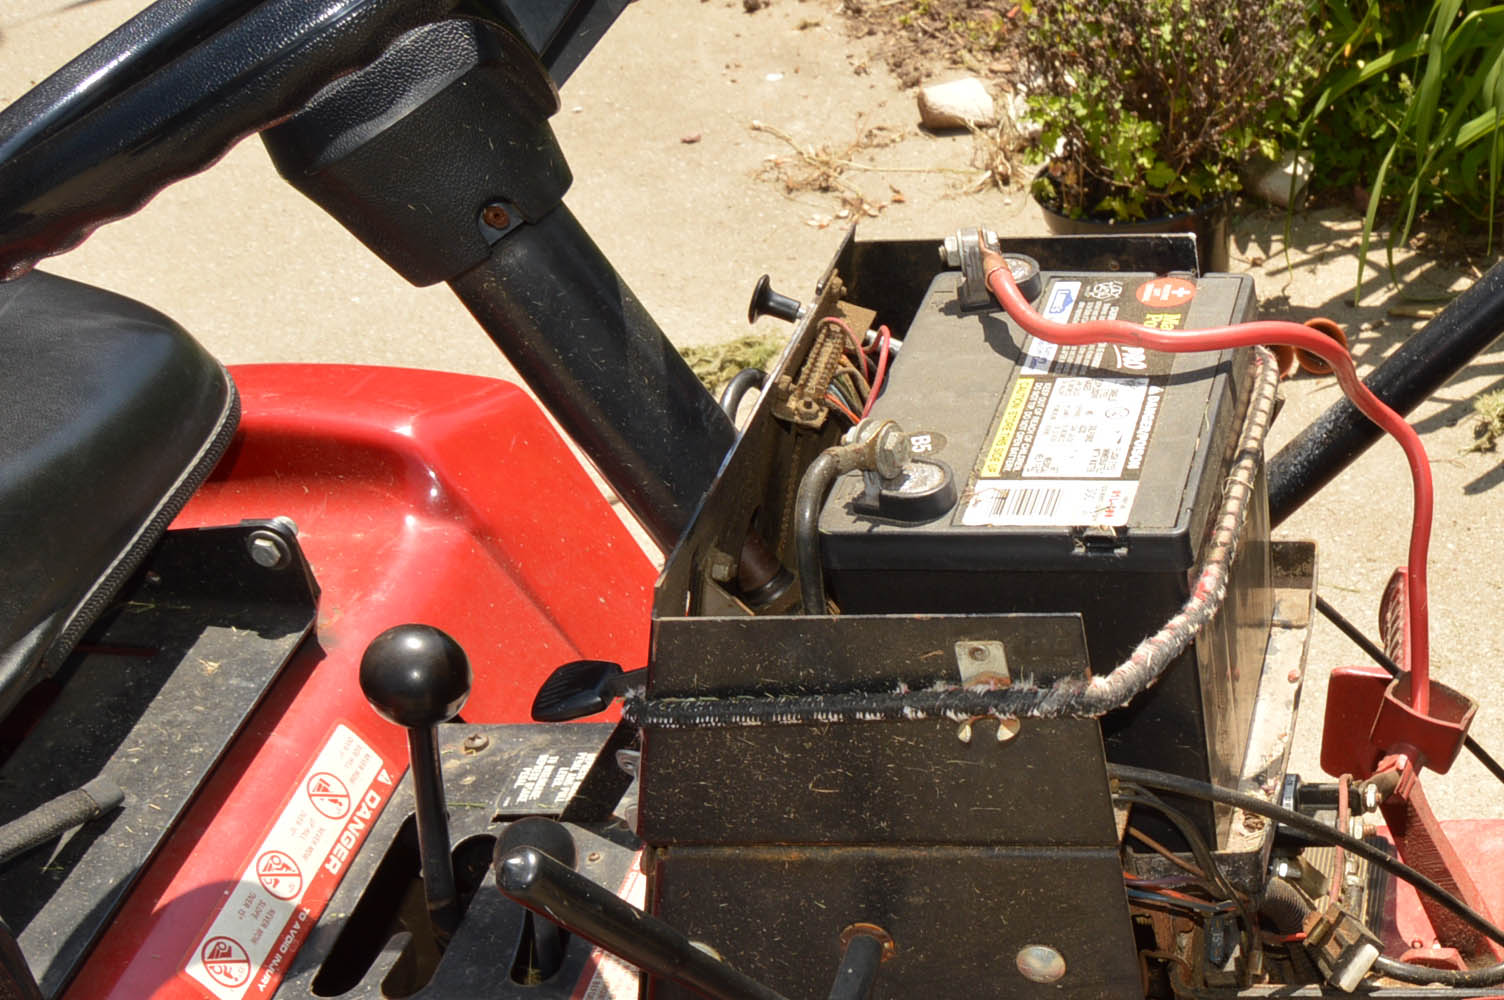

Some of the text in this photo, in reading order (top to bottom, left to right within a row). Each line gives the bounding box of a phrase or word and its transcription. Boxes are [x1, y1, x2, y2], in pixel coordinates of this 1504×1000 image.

[910, 434, 932, 452] B5
[1126, 395, 1160, 470] DANGER/POISON
[324, 789, 381, 874] DANGER
[242, 891, 256, 910] OVER
[251, 899, 266, 919] SLOPE
[250, 908, 275, 945] NEVER MOW
[257, 906, 310, 991] TO AVOID INJURY
